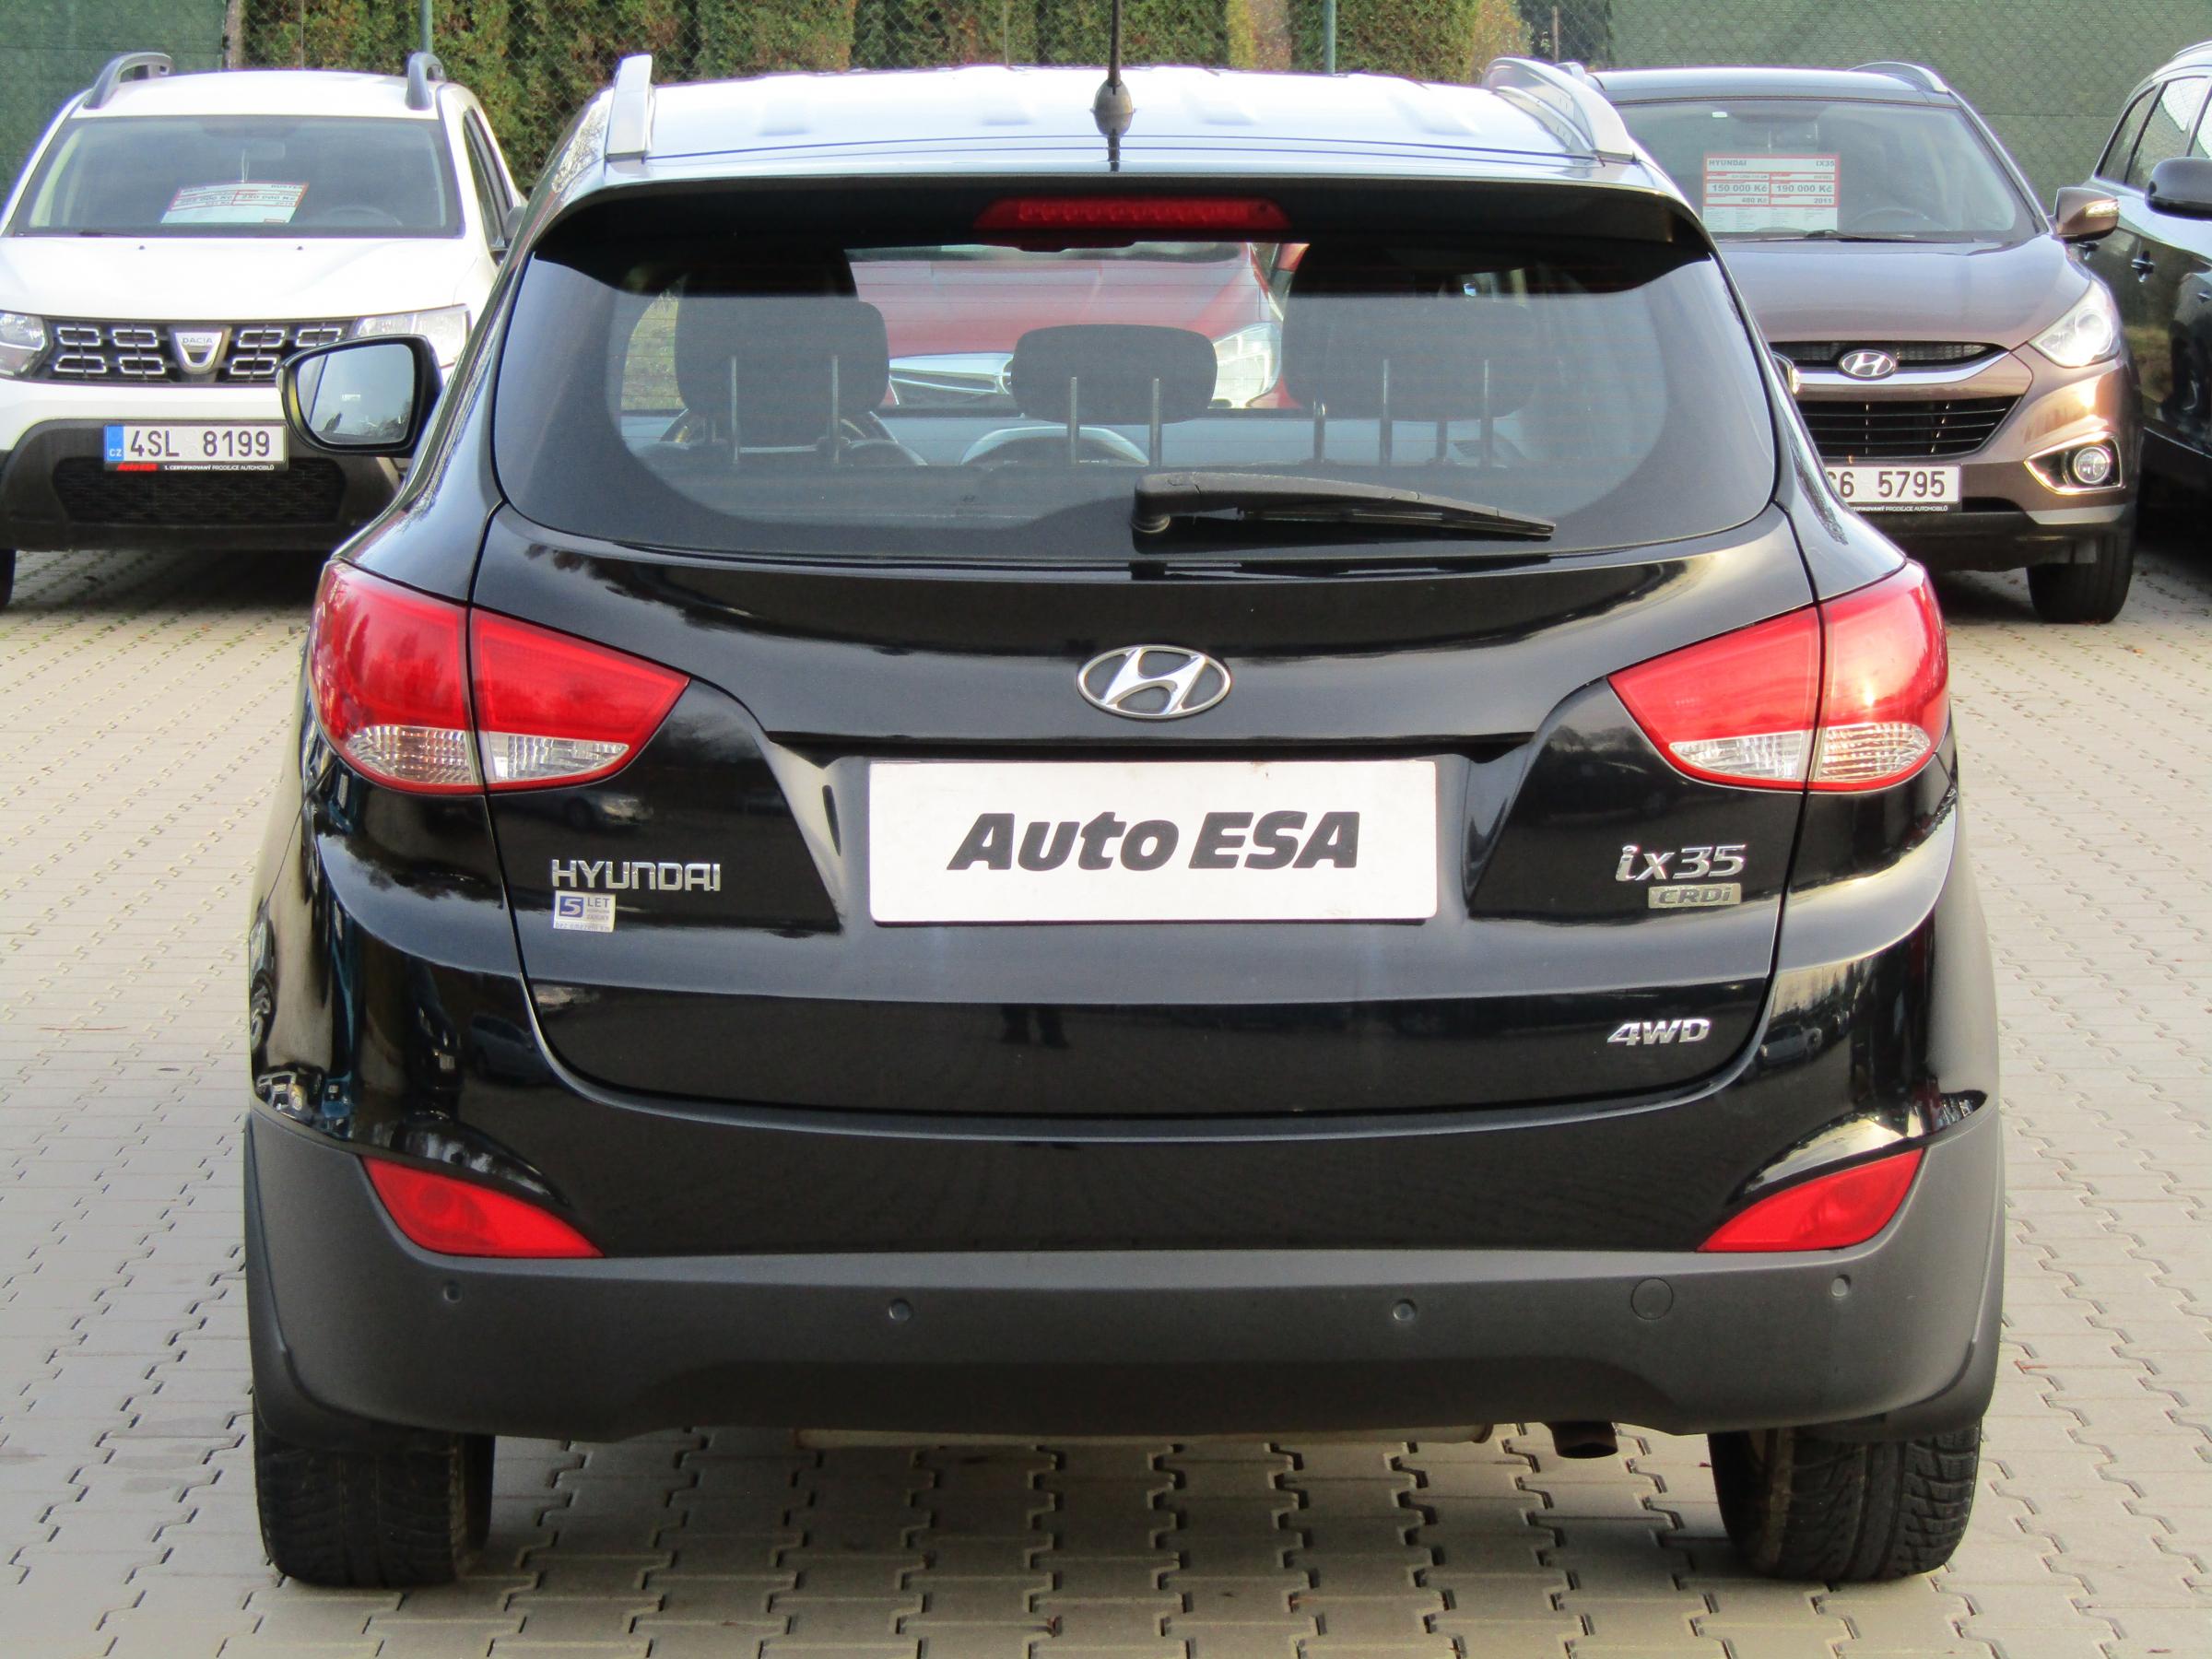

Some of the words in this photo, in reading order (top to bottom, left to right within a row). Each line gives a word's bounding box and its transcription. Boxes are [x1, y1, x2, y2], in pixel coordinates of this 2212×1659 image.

[1712, 184, 1730, 193] 150
[1733, 184, 1751, 193] 000
[1754, 182, 1768, 193] Kč
[1776, 184, 1794, 193] 190
[1797, 184, 1816, 193] 000
[1818, 183, 1832, 193] Kč
[109, 449, 123, 457] CZ
[130, 429, 180, 458] 4SL
[203, 429, 270, 458] 8199
[1877, 471, 1946, 498] 5795
[946, 811, 1180, 872] Auto
[1187, 809, 1361, 871] ESA
[551, 859, 721, 892] HYUNDAI
[1615, 843, 1747, 882] ix35
[560, 898, 582, 915] 5
[587, 896, 611, 908] LET
[1659, 887, 1733, 904] CRDi
[1606, 1018, 1712, 1046] 4WD
